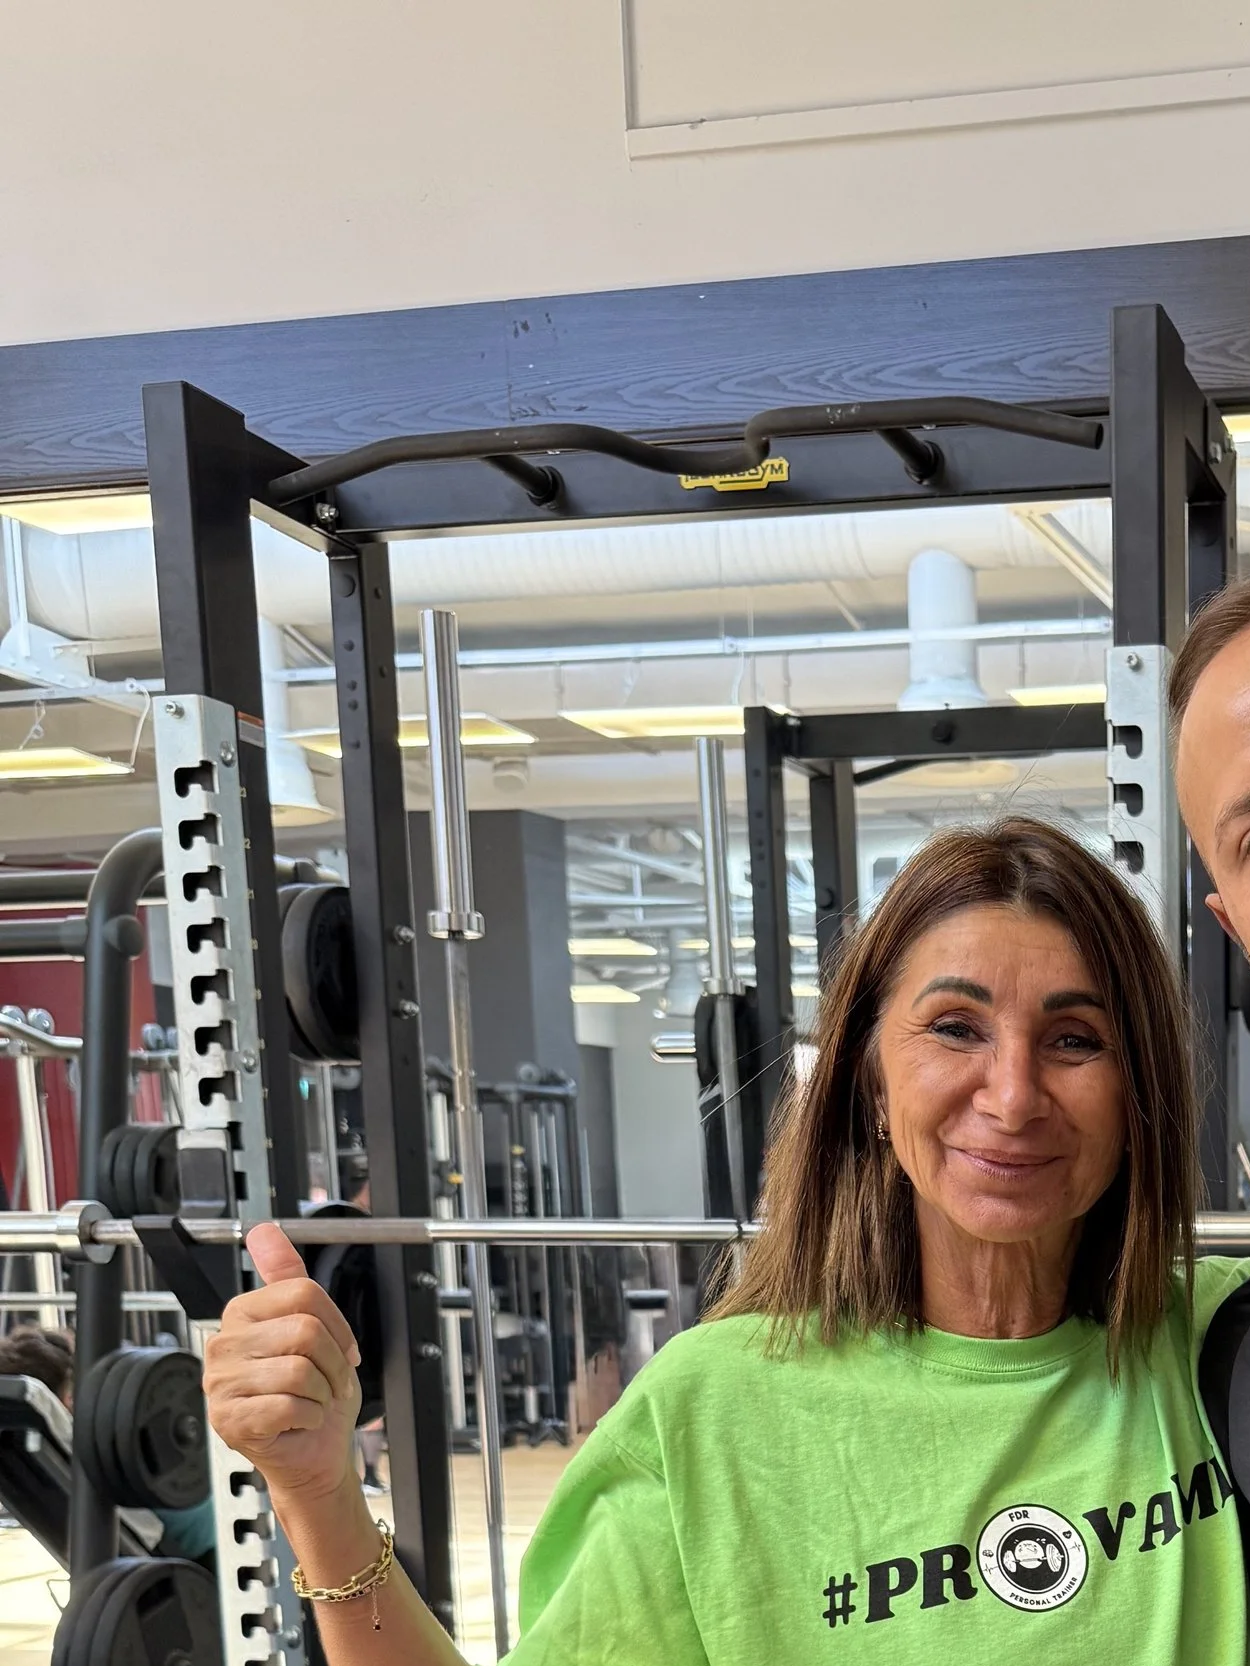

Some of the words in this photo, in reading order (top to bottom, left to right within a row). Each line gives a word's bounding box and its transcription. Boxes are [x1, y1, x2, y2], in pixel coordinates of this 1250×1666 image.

[1008, 1510, 1030, 1522] FDR
[1009, 1592, 1052, 1606] PERSONAL
[1052, 1576, 1078, 1601] TRAINER
